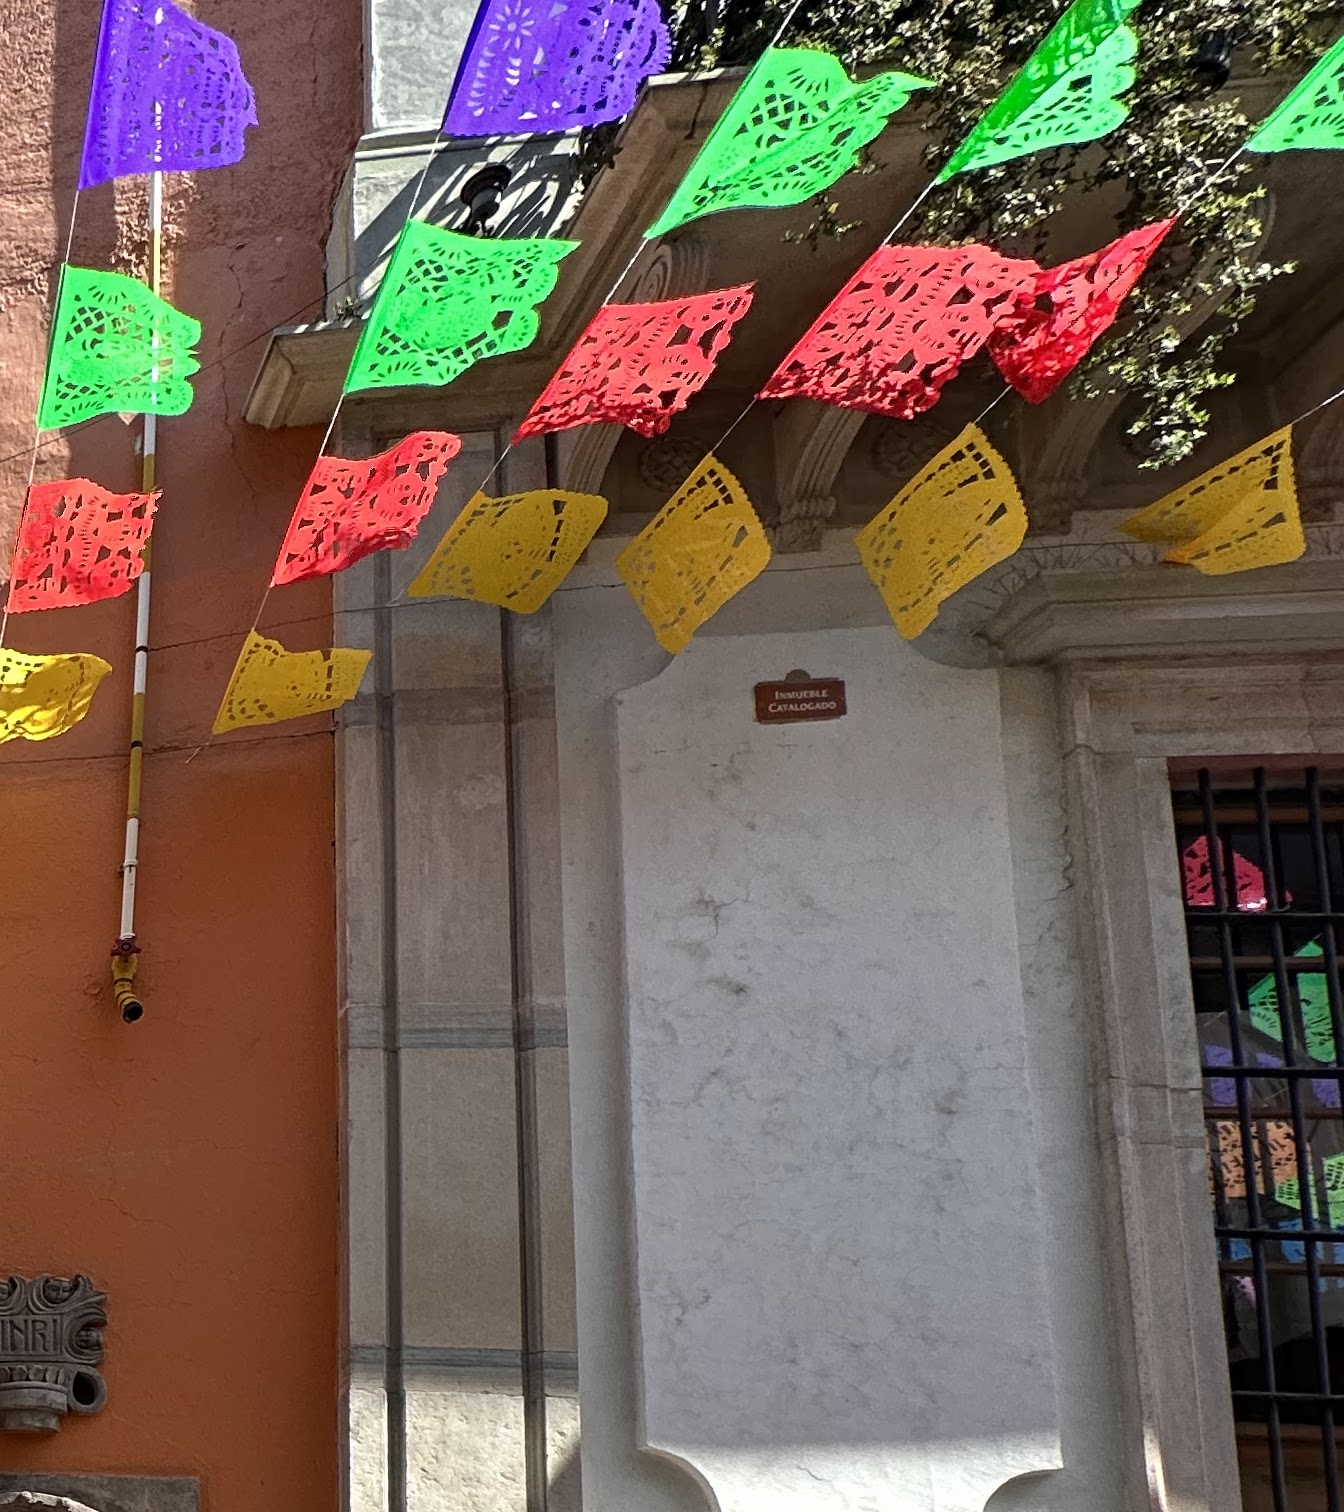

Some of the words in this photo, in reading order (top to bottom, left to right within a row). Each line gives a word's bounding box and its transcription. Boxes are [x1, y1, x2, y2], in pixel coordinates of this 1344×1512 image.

[775, 689, 829, 700] INMUEBLE
[768, 701, 837, 713] CATALOGADO
[0, 1318, 61, 1352] INRI
